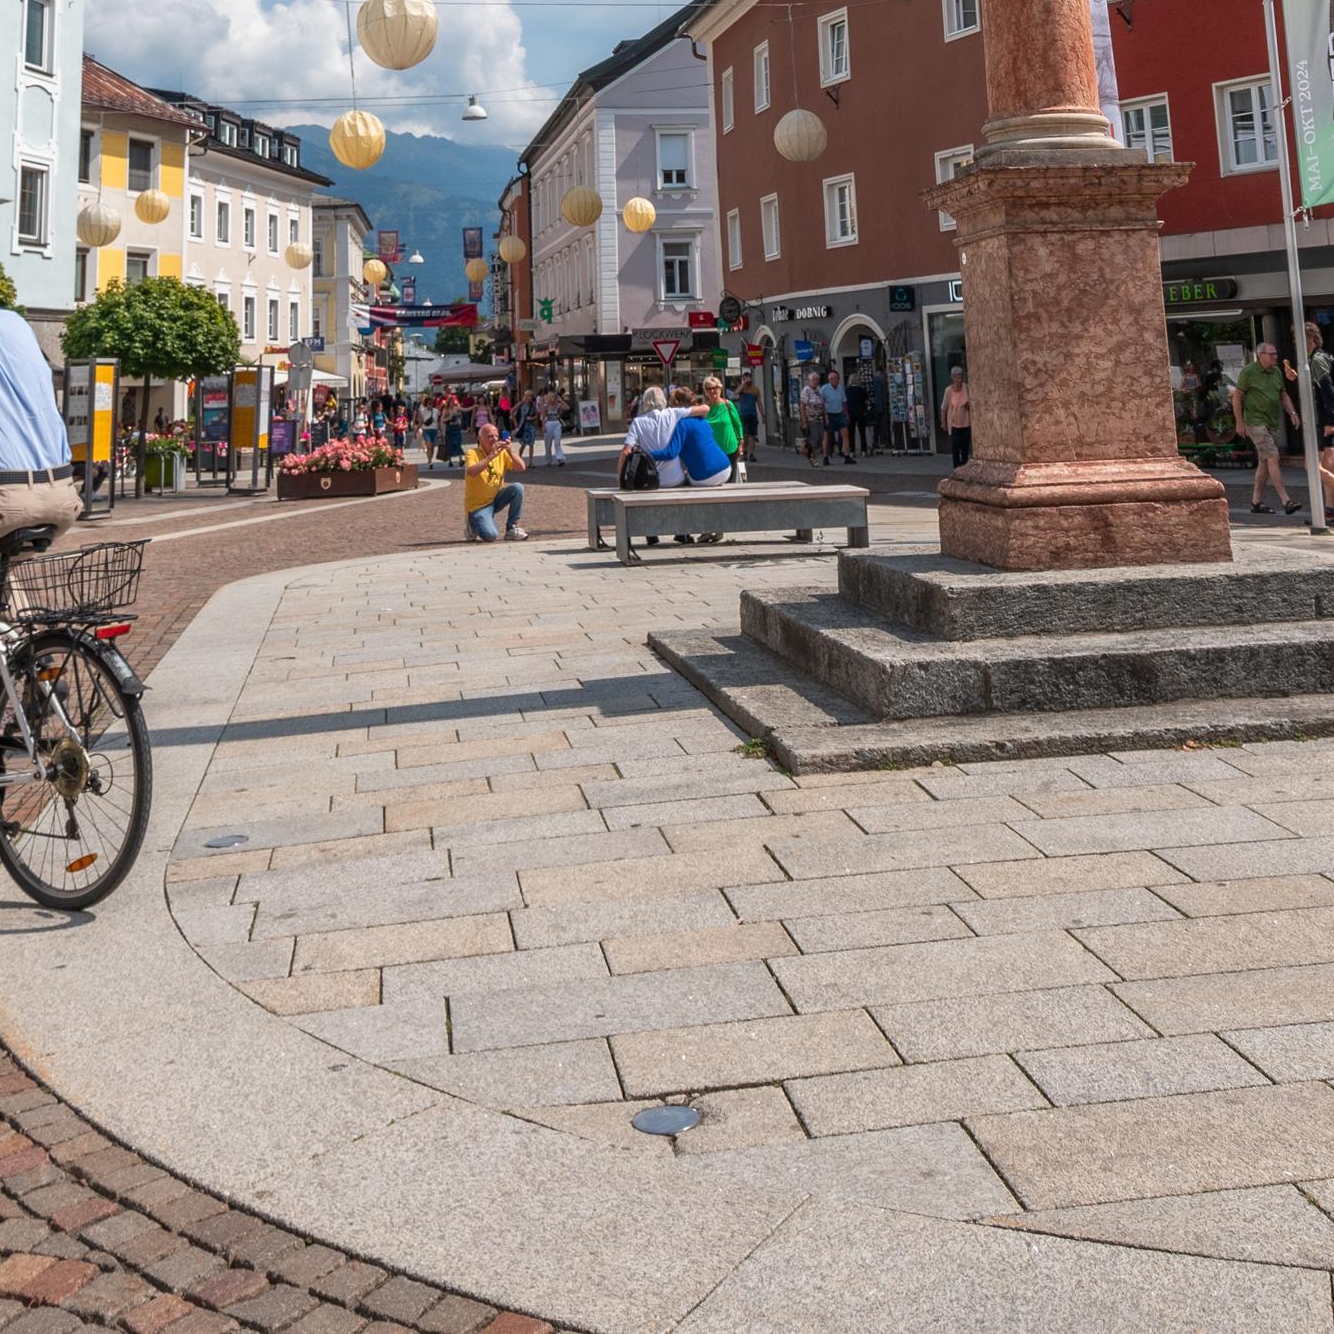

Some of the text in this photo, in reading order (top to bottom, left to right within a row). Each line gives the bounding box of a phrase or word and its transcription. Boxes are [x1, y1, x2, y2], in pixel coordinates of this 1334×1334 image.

[1296, 59, 1311, 102] 2024
[796, 305, 827, 320] DOBNIG
[632, 328, 693, 340] KLOCKWERK
